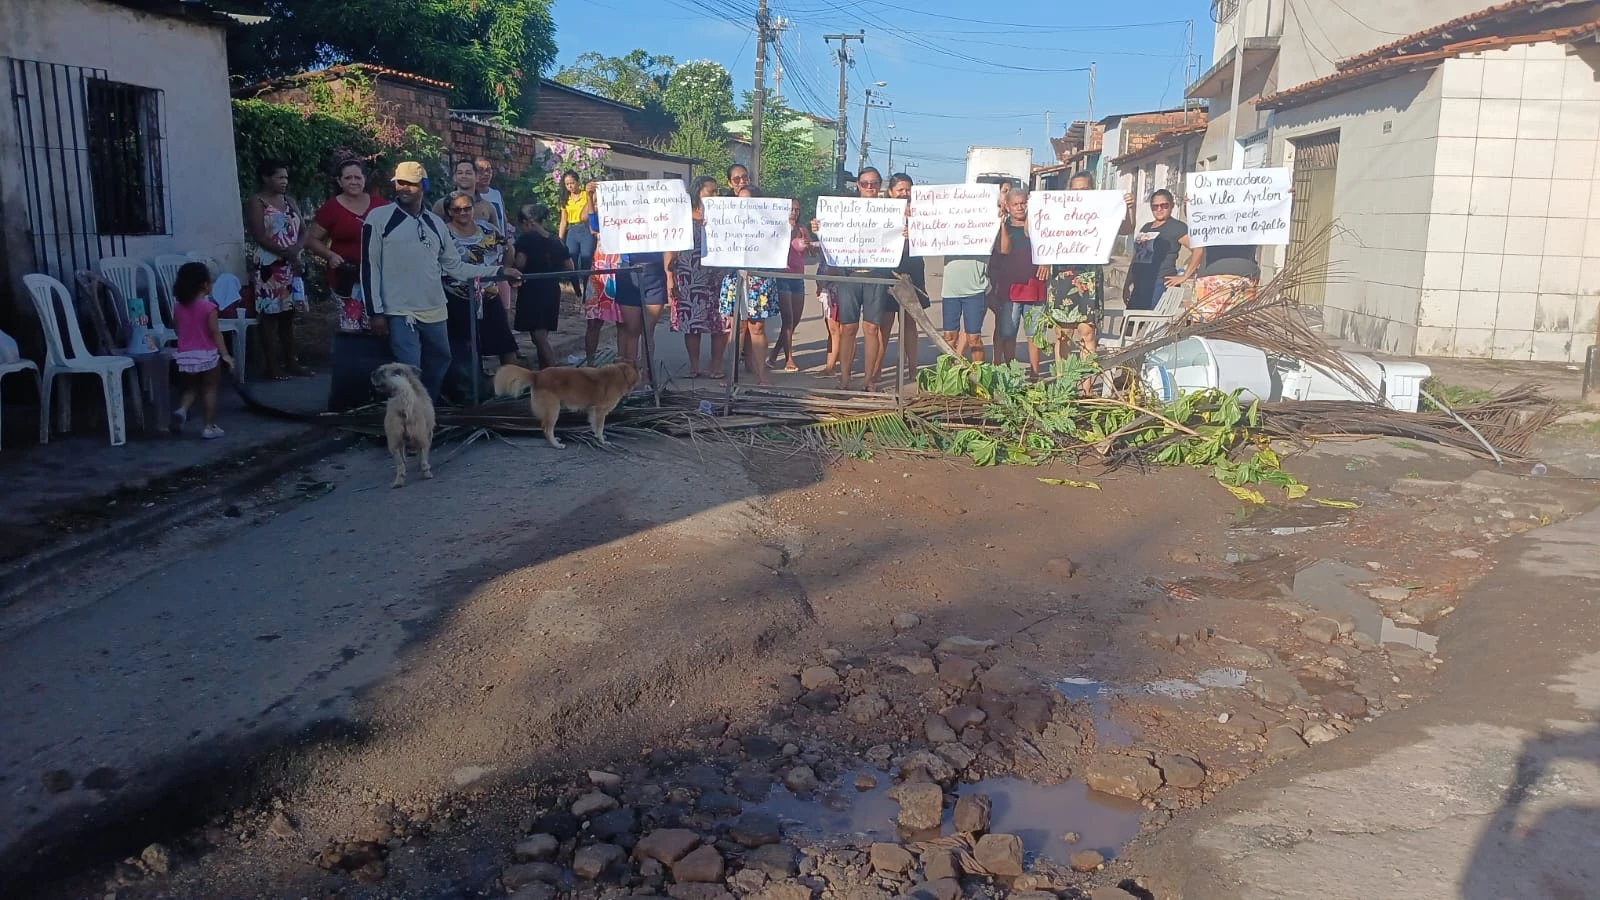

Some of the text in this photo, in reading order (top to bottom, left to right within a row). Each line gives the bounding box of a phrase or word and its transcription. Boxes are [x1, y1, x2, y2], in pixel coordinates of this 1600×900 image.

[1194, 171, 1273, 188] Os moradores
[1190, 193, 1203, 206] da
[1209, 190, 1235, 205] Vila
[1192, 208, 1261, 223] Senna pede
[883, 218, 895, 229] de
[1237, 225, 1248, 233] no
